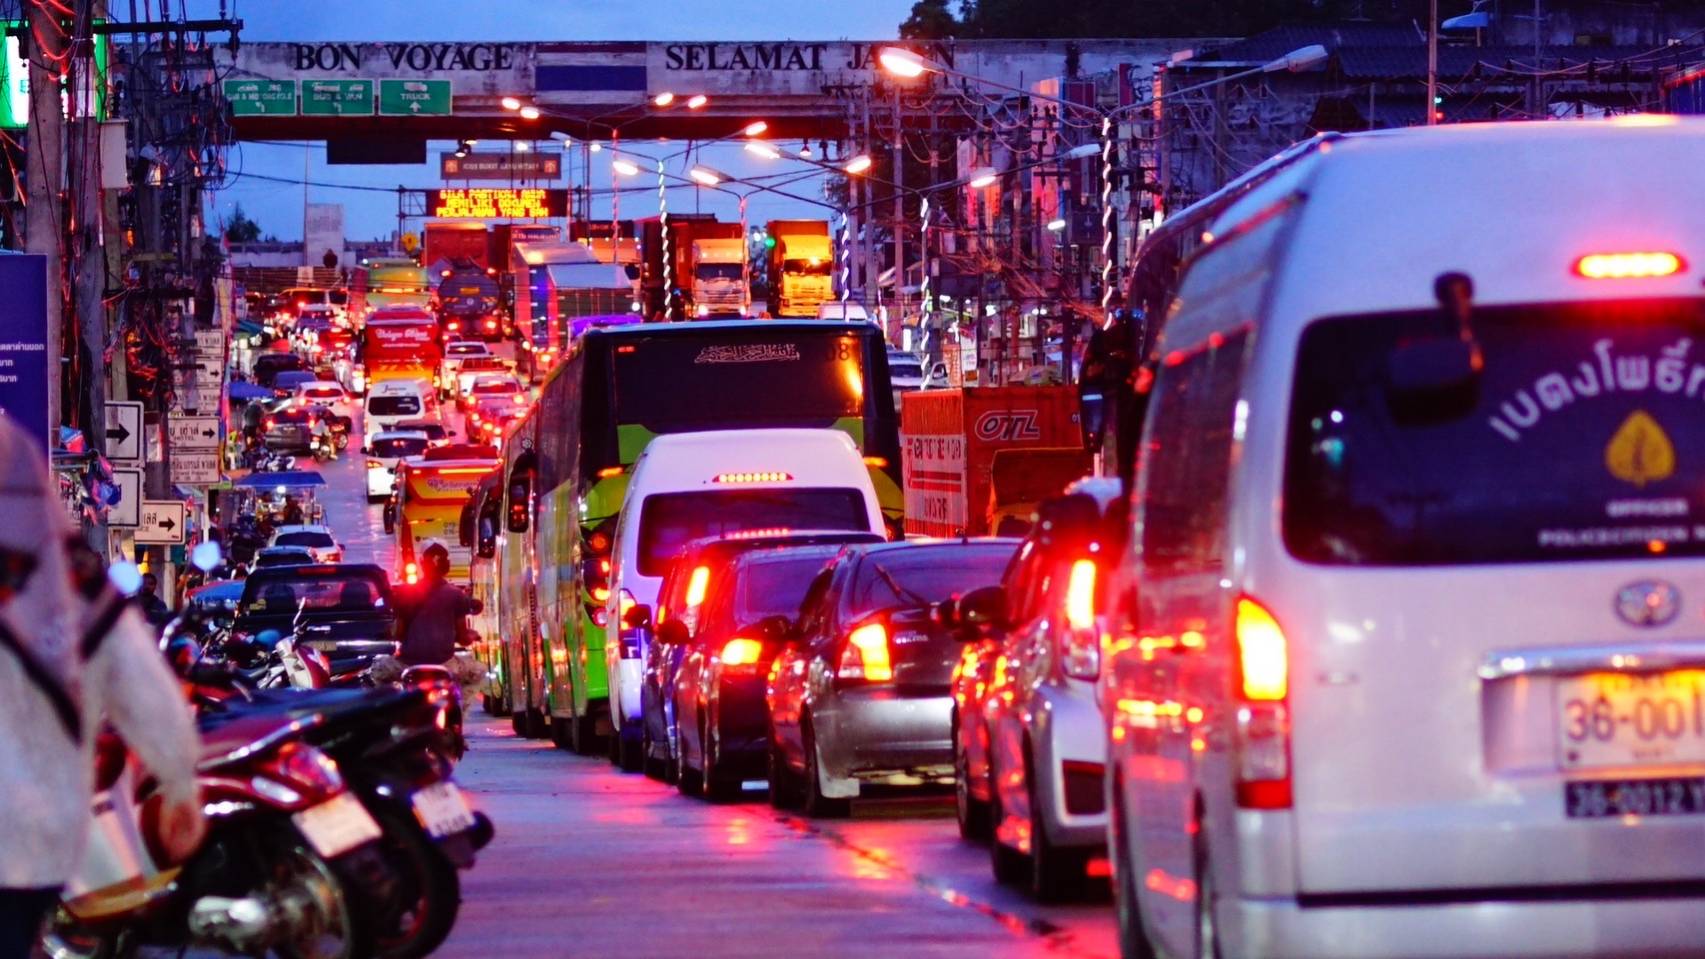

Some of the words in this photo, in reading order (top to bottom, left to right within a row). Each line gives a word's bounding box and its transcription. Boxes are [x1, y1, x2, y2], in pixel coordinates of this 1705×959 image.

[295, 44, 362, 71] BON
[385, 44, 512, 71] VOYAGE
[665, 44, 827, 71] SELAMAT
[846, 43, 956, 71] JAN
[400, 92, 431, 101] TRUCK
[978, 412, 1040, 440] OTL
